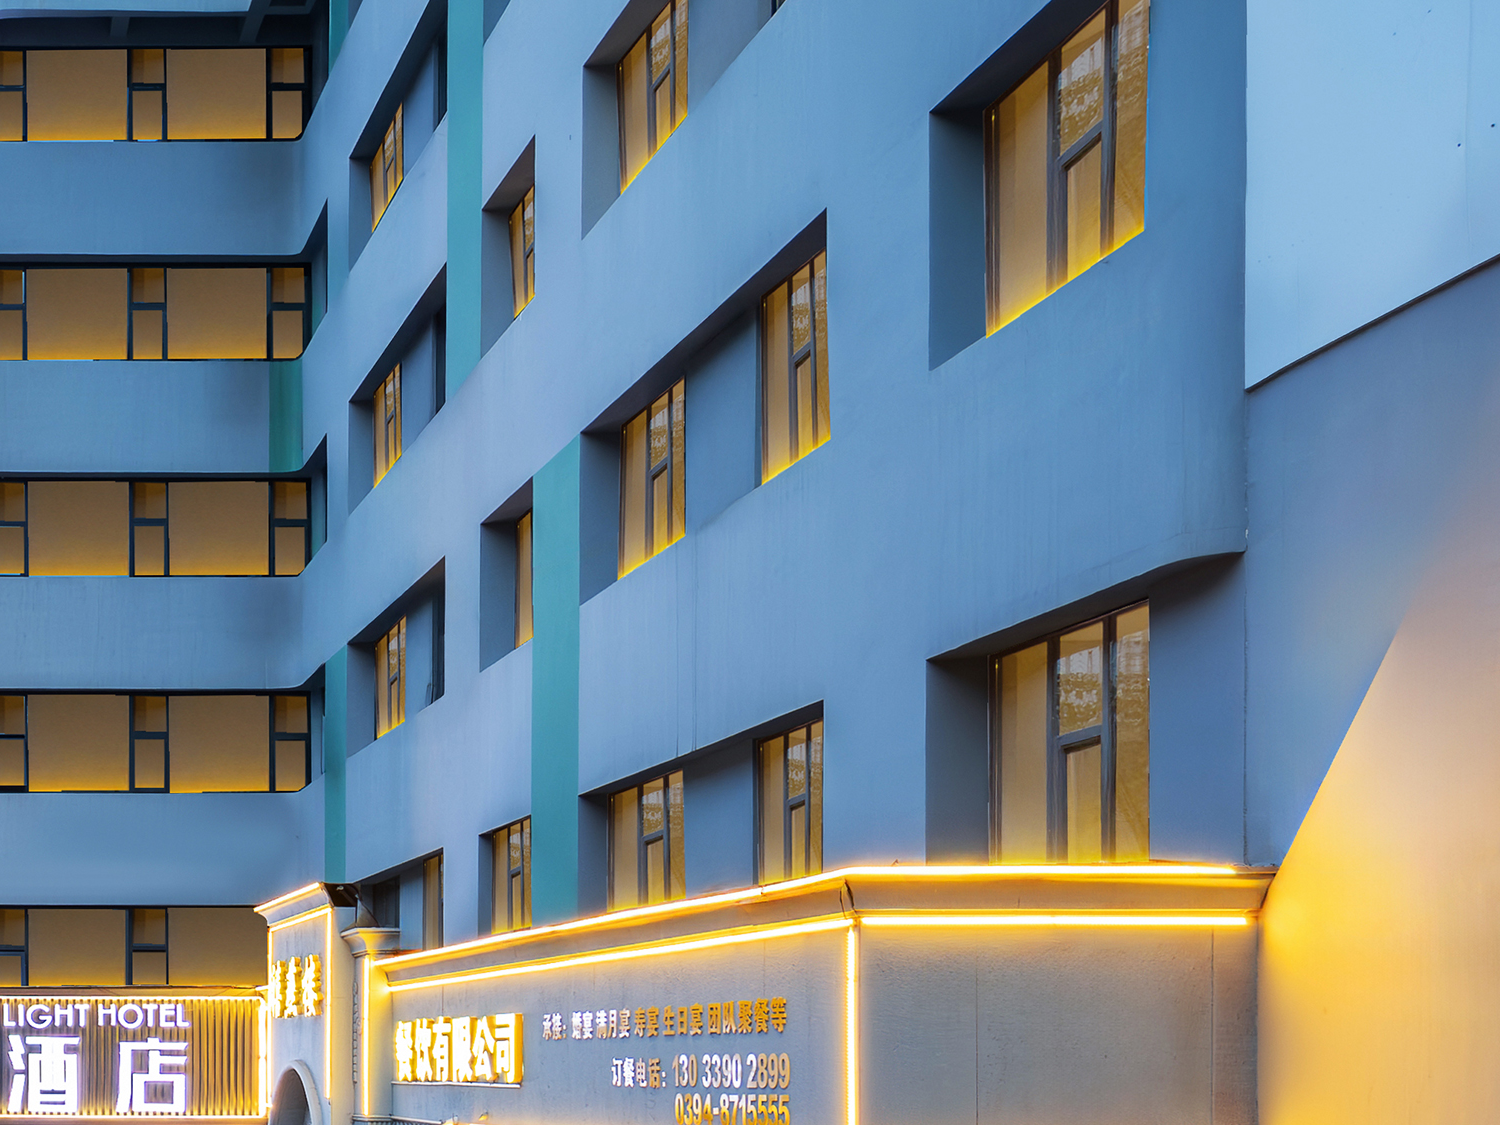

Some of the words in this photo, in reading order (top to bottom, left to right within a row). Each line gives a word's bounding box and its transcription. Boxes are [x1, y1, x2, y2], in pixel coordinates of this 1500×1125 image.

[2, 1002, 90, 1030] LIGHT
[97, 1002, 191, 1030] HOTEL
[595, 1007, 631, 1039] 满月宴
[634, 1005, 660, 1038] 寿宴
[662, 1003, 703, 1037] 生日宴
[707, 996, 788, 1035] 团队聚餐等
[671, 1053, 698, 1088] 130
[702, 1053, 743, 1089] 3390
[746, 1052, 791, 1090] 2899
